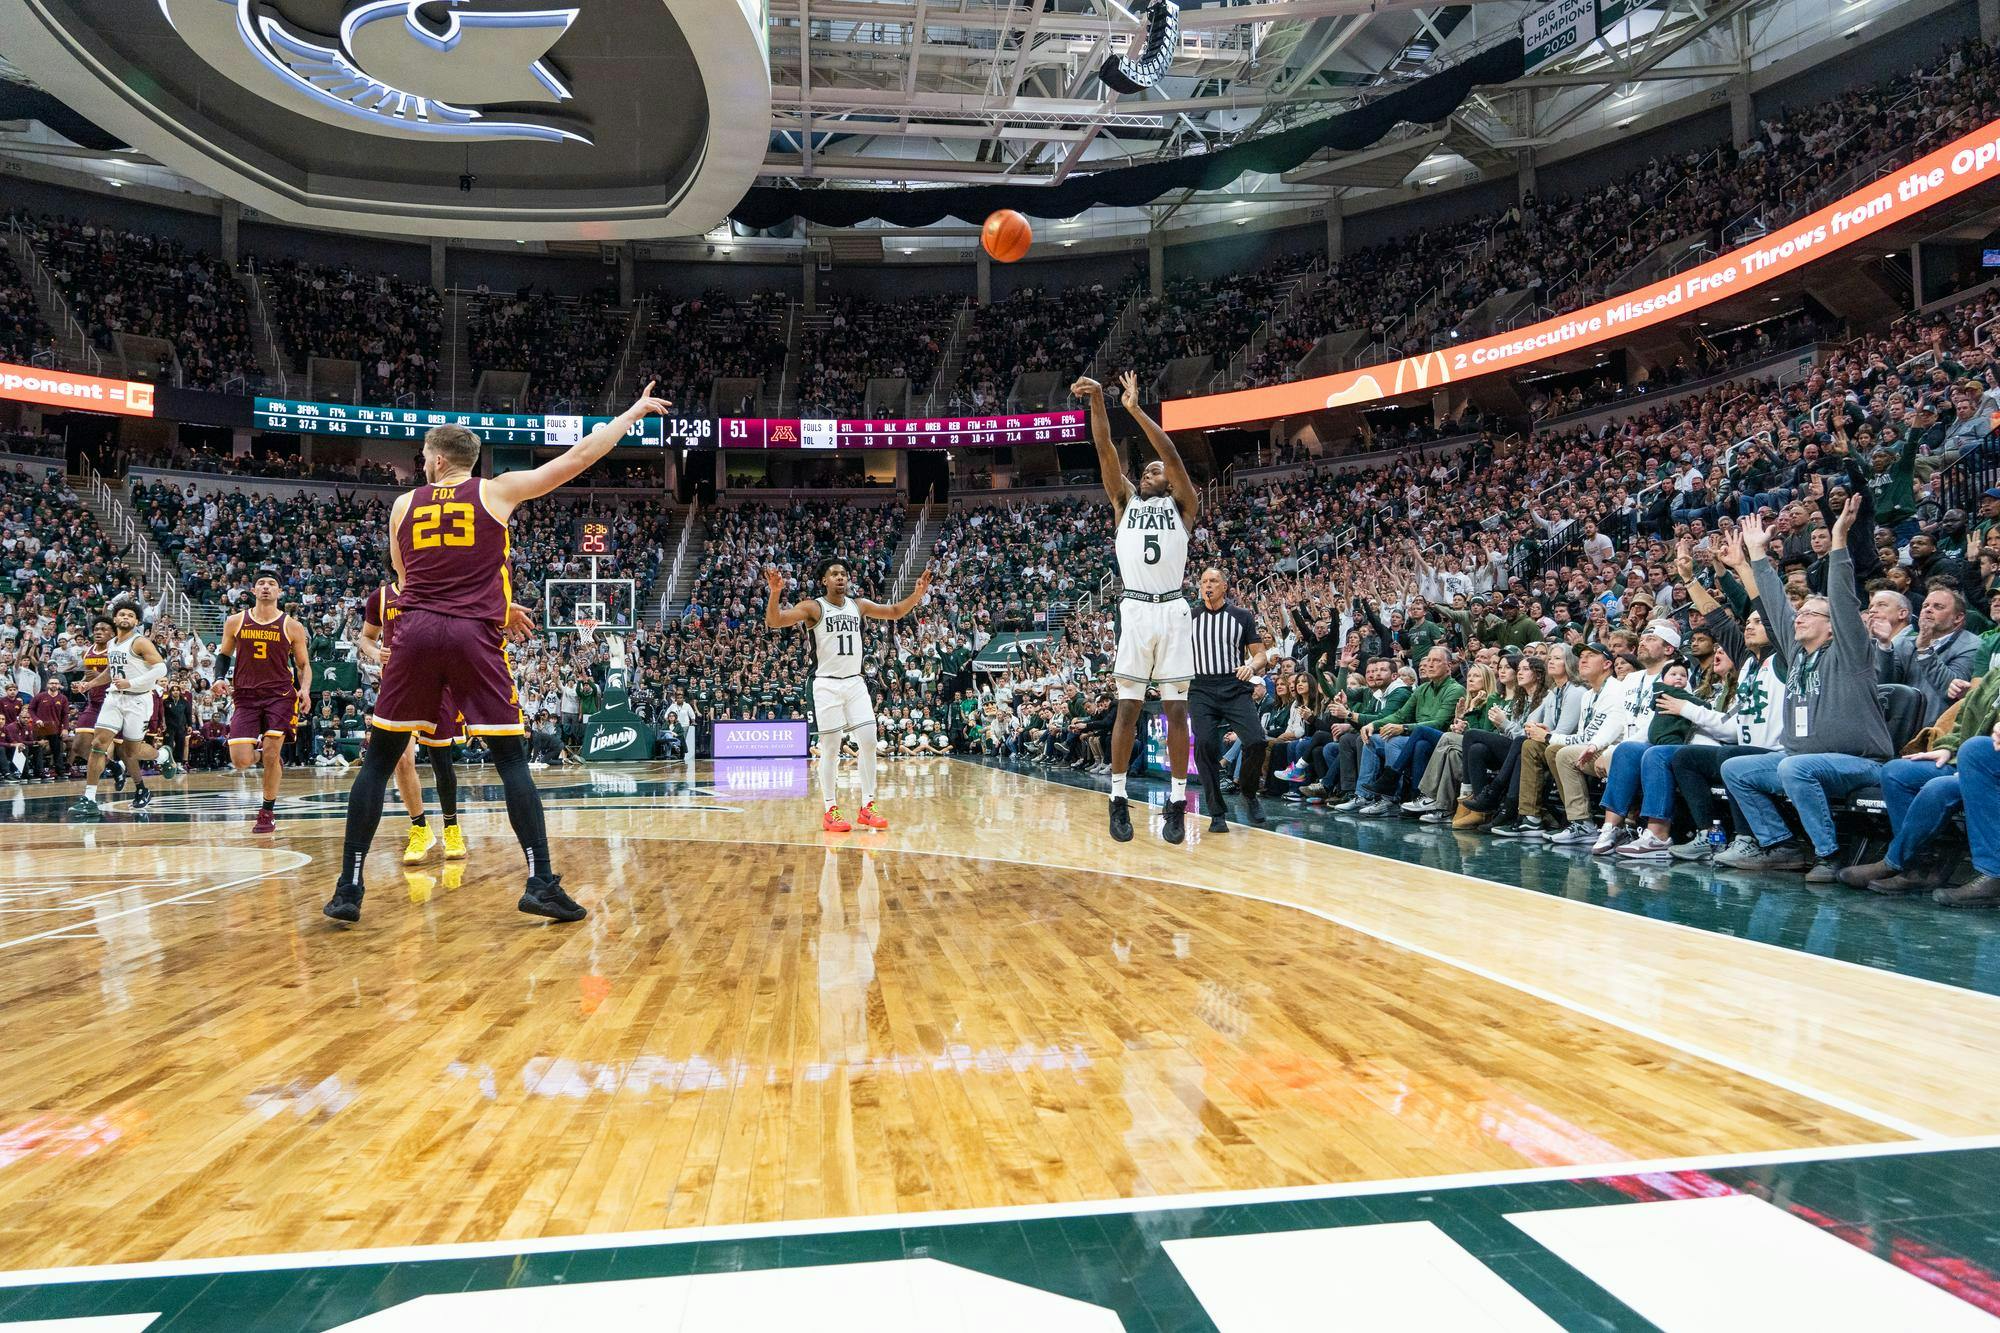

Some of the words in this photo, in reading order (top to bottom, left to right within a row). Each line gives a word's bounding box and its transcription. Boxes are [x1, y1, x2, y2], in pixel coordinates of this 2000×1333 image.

[1538, 9, 1556, 27] BIG
[1558, 0, 1578, 13] TEN
[1527, 2, 1592, 47] CHAMPIONS
[1544, 32, 1576, 57] 2020
[1710, 90, 1726, 102] 224
[1464, 172, 1478, 181] 223
[1454, 353, 1468, 370] 2
[1471, 316, 1602, 364] Consecutive
[1606, 285, 1681, 327] Missed
[1686, 266, 1738, 299] Free
[1741, 224, 1826, 274] Throws
[1830, 192, 1893, 235] from
[1898, 166, 1945, 202] the
[269, 402, 286, 413] FG%
[297, 405, 319, 416] 3FG%
[330, 408, 346, 418] FT%
[358, 410, 374, 420] FTM
[380, 411, 394, 421] FTA
[403, 413, 417, 423] REB
[457, 416, 470, 425] AST
[481, 417, 494, 426] BLK
[507, 417, 515, 427] TO
[527, 418, 539, 428] STL
[547, 419, 566, 428] FOULS
[574, 419, 578, 428] 5
[842, 423, 852, 432] STL
[865, 423, 872, 432] TO
[885, 423, 896, 432] BLK
[906, 423, 917, 432] AST
[926, 422, 941, 431] OREB
[949, 422, 960, 431] REB
[1007, 419, 1020, 428] FT%
[1034, 417, 1051, 427] 3FG%
[1062, 415, 1075, 425] FG%
[268, 417, 286, 428] 51.2
[299, 419, 317, 430] 37.5
[329, 422, 346, 432] 54.5
[405, 427, 415, 436] 18
[485, 431, 489, 440] 1
[509, 432, 513, 441] 2
[531, 432, 535, 441] 5
[670, 419, 710, 437] 12:36
[730, 421, 747, 438] 51
[865, 436, 873, 445] 13
[908, 436, 916, 444] 10
[931, 436, 935, 444] 4
[951, 435, 958, 444] 23
[1007, 432, 1021, 441] 71.4
[1035, 430, 1050, 440] 53.8
[1062, 428, 1076, 438] 53.1
[547, 433, 558, 442] TOL
[574, 433, 578, 442] 3
[432, 488, 456, 500] FOX
[412, 502, 475, 550] 23
[1127, 508, 1176, 530] STATE
[583, 535, 604, 552] 25
[1144, 534, 1161, 565] 5
[826, 616, 859, 632] STATE
[241, 630, 280, 642] MINNESOTA
[254, 642, 266, 659] 3
[837, 634, 853, 656] 11
[590, 730, 633, 753] LIBMAN
[727, 730, 770, 742] AXIOS
[773, 730, 793, 741] HR
[1742, 726, 1751, 744] 5
